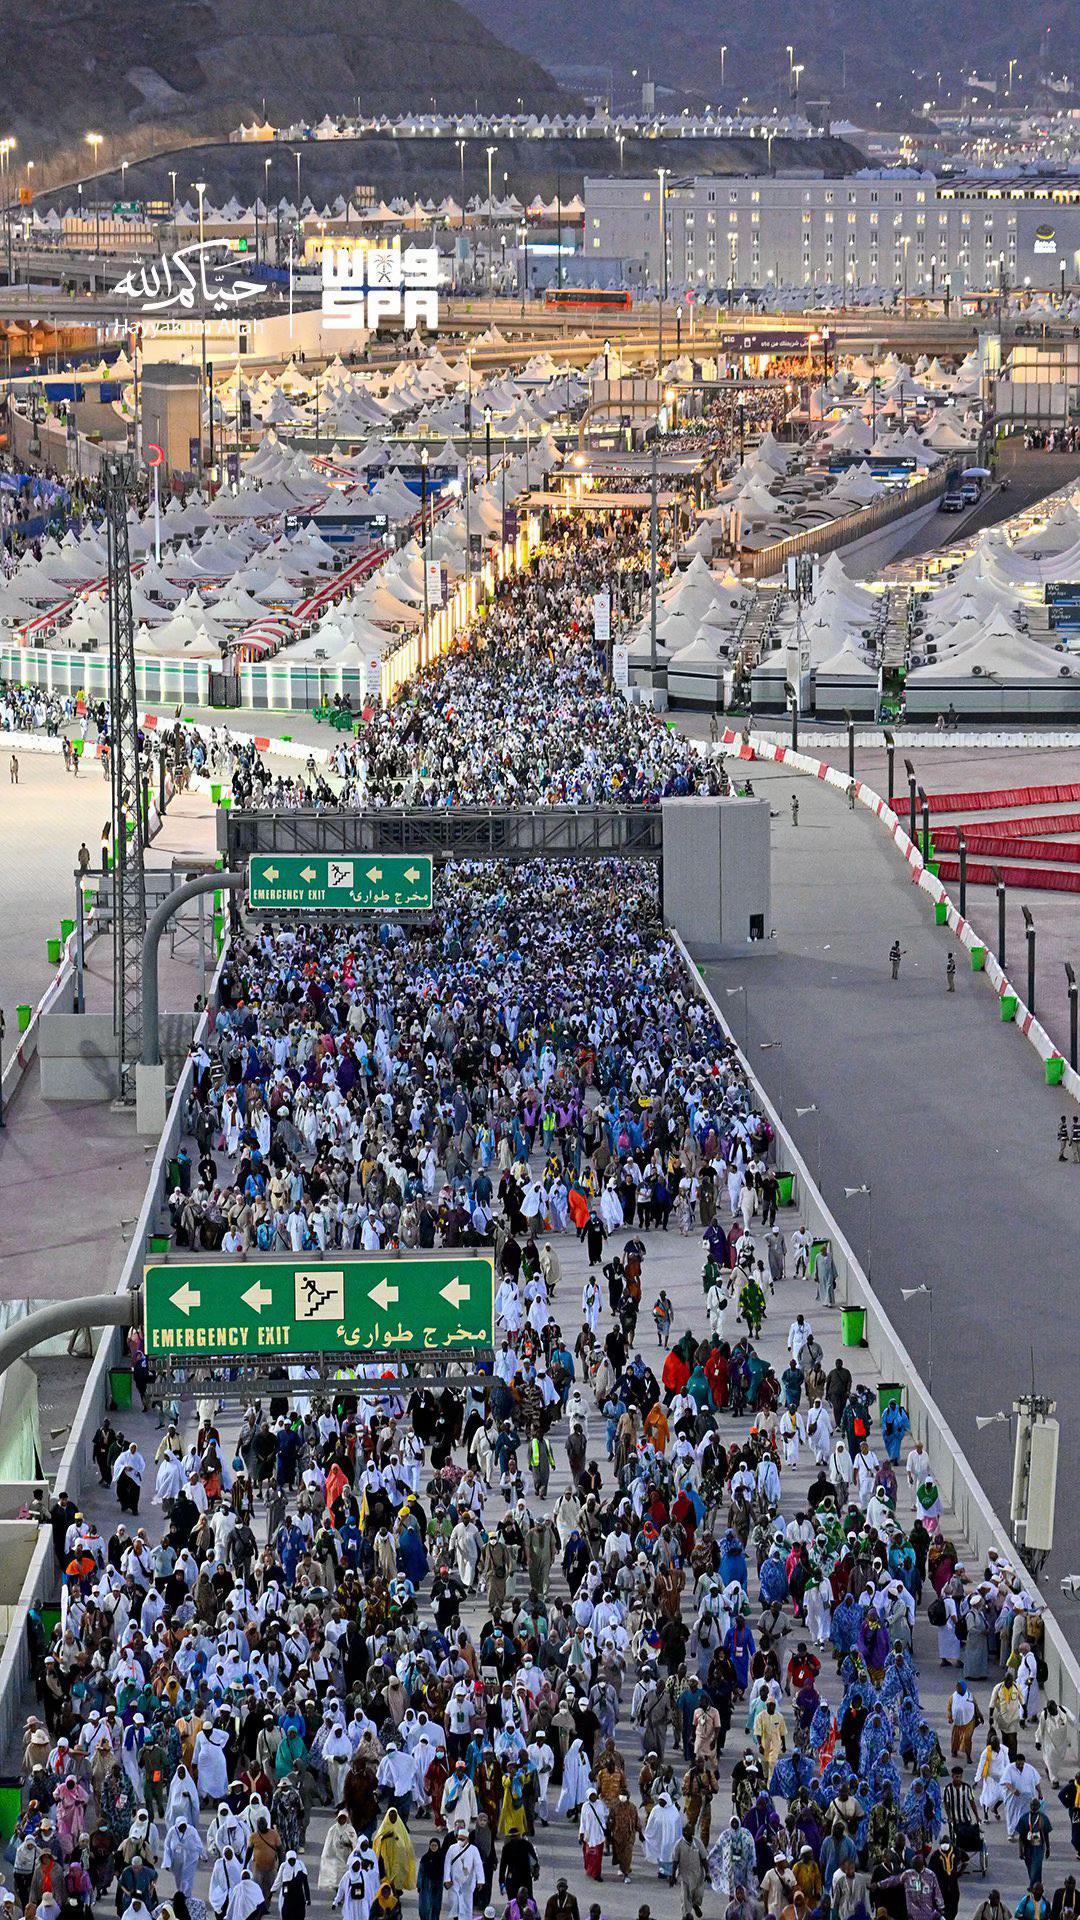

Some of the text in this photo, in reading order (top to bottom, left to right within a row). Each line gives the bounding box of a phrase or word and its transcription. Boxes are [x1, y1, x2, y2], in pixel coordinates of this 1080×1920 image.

[253, 889, 326, 900] EMERGENCY EXIT
[394, 890, 428, 904] مخرج
[152, 1325, 291, 1348] EMERGENCY EXIT
[423, 1324, 486, 1348] مخرج
